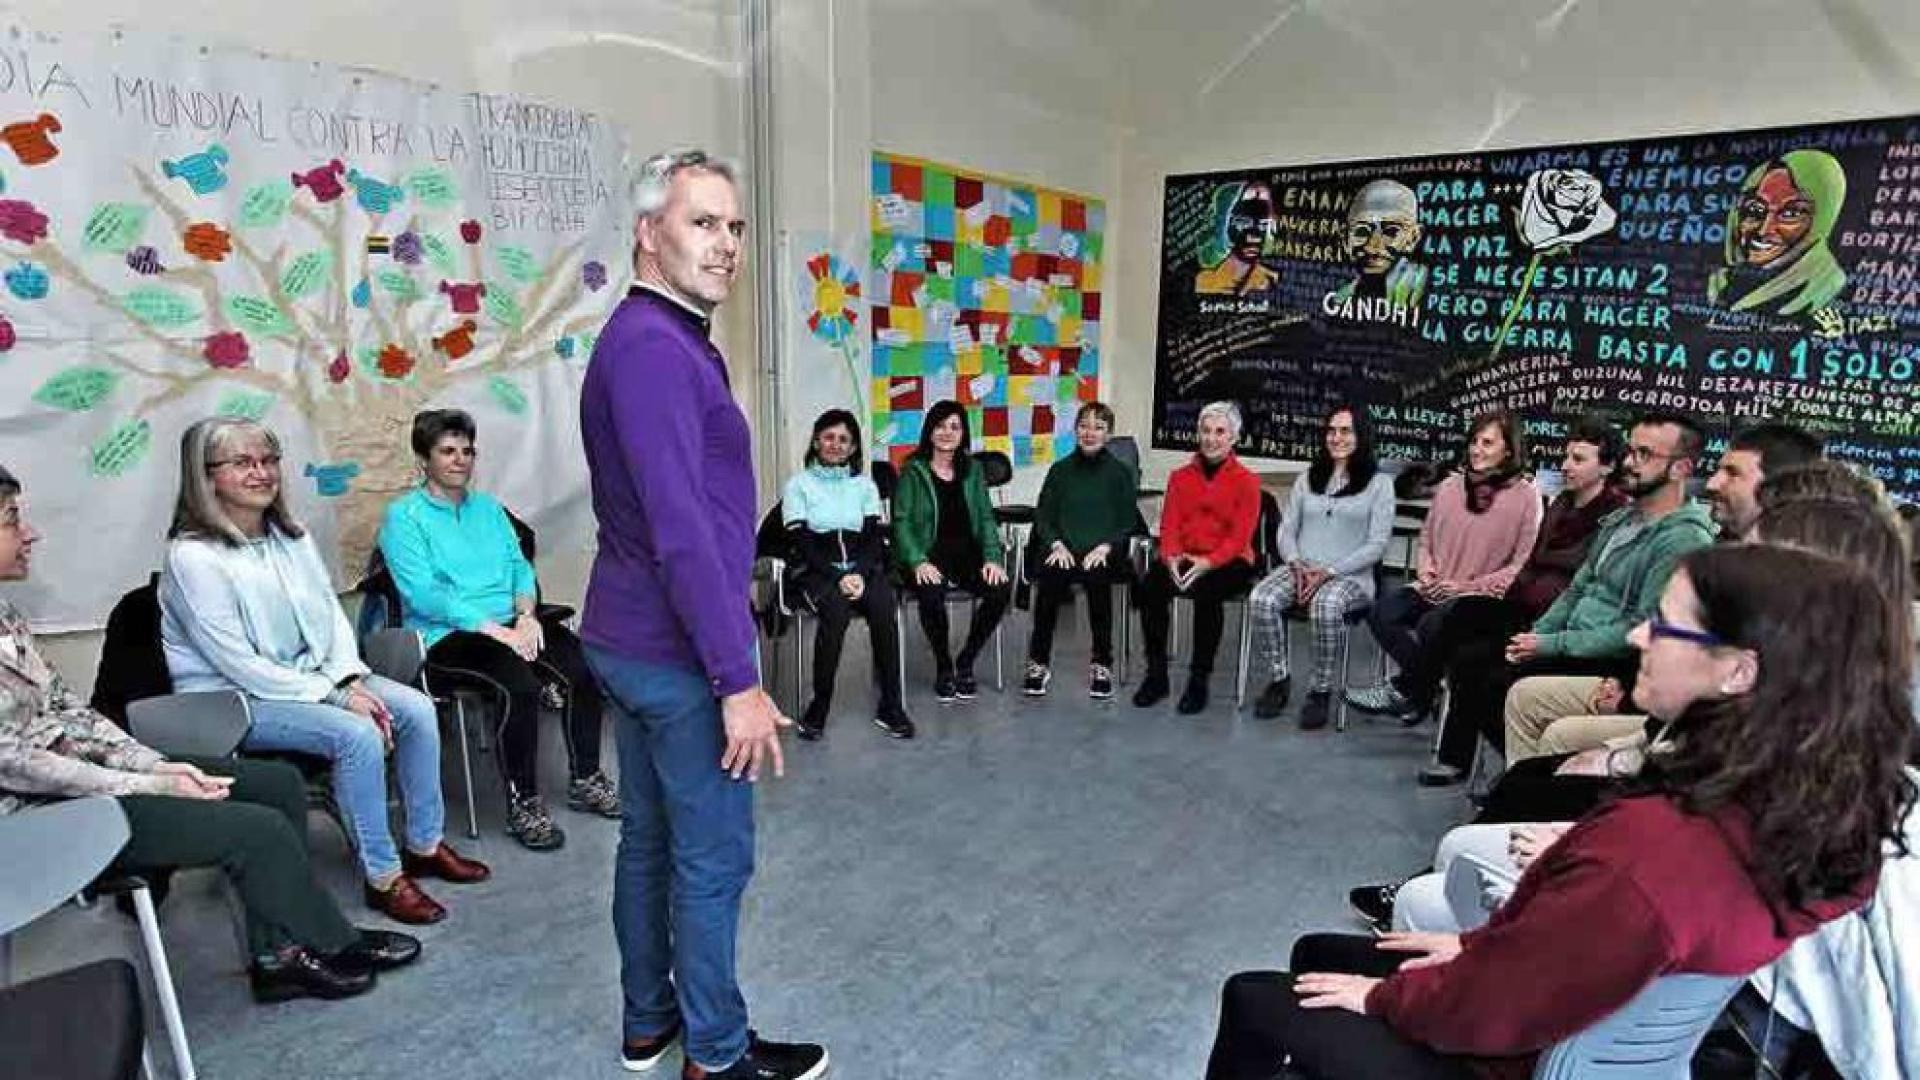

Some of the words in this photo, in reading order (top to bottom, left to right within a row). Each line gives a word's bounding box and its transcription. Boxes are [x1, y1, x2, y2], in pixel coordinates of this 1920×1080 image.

[112, 72, 280, 141] MUNDIAL
[288, 106, 414, 156] CONTRA
[426, 122, 468, 160] LA
[1599, 149, 1631, 166] ES
[1642, 146, 1679, 165] UN
[1606, 164, 1746, 188] ENEMIGO
[1416, 181, 1486, 202] PARA
[1620, 192, 1692, 214] PARA
[1417, 203, 1501, 227] HACER
[1619, 215, 1727, 242] DUEÑO
[1423, 234, 1453, 255] LA
[1462, 235, 1512, 258] PAZ
[1431, 263, 1459, 287] SE
[1473, 262, 1638, 291] NECESITAN
[1644, 262, 1670, 296] 2
[1321, 291, 1420, 327] GANDHI
[1426, 293, 1489, 318] PERO
[1498, 296, 1567, 321] PARA
[1582, 304, 1672, 332] HACER
[1421, 318, 1447, 342] LA
[1461, 321, 1570, 351] GUERRA
[1597, 333, 1688, 369] BASTA
[1706, 345, 1775, 374] CON
[1788, 337, 1808, 380] 1
[1821, 350, 1914, 381] SOLO
[1571, 365, 1644, 382] DUZUNA
[1655, 371, 1686, 389] HIL
[1699, 376, 1816, 399] DEZAKEZU
[1367, 403, 1398, 420] NCA
[1507, 389, 1547, 410] EZIN
[1555, 385, 1606, 401] DUZU
[1618, 388, 1726, 413] GORROTOA
[1732, 399, 1776, 418] HIL
[1520, 420, 1568, 437] JORES
